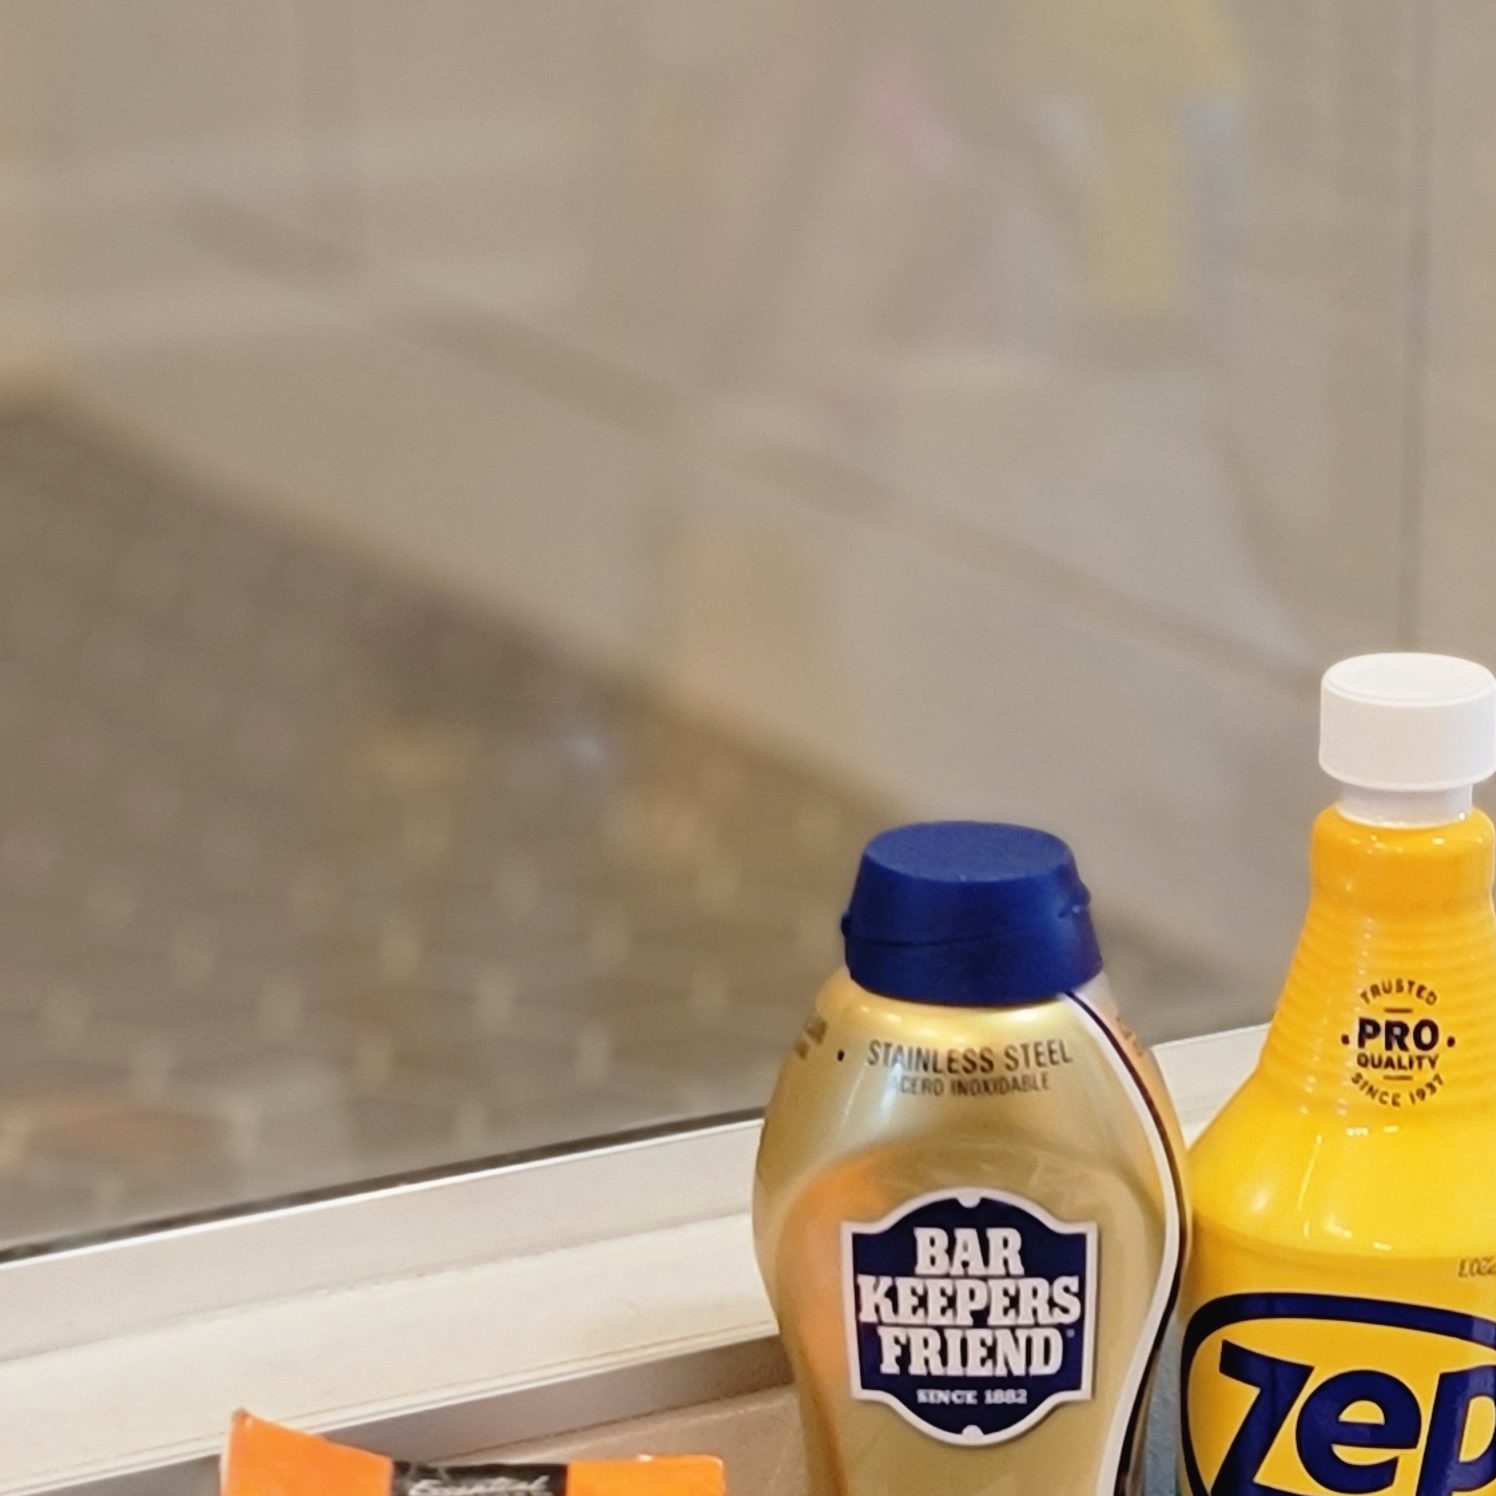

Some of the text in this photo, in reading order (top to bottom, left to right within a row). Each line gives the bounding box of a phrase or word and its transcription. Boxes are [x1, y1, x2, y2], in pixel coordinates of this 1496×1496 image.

[1360, 978, 1437, 1006] TRUSTED
[1357, 1017, 1440, 1052] PRO
[867, 1039, 995, 1075] STAINLESS
[1003, 1038, 1074, 1072] STEEL
[1357, 1053, 1439, 1071] QUALITY
[951, 1070, 1050, 1097] INOXIDABLE
[1351, 1072, 1444, 1107] SINCE 1937
[913, 1226, 1024, 1276] BAR
[856, 1275, 1082, 1326] KEEPERS
[876, 1325, 1064, 1378] FRIEND
[916, 1389, 1028, 1405] SINCE 1882
